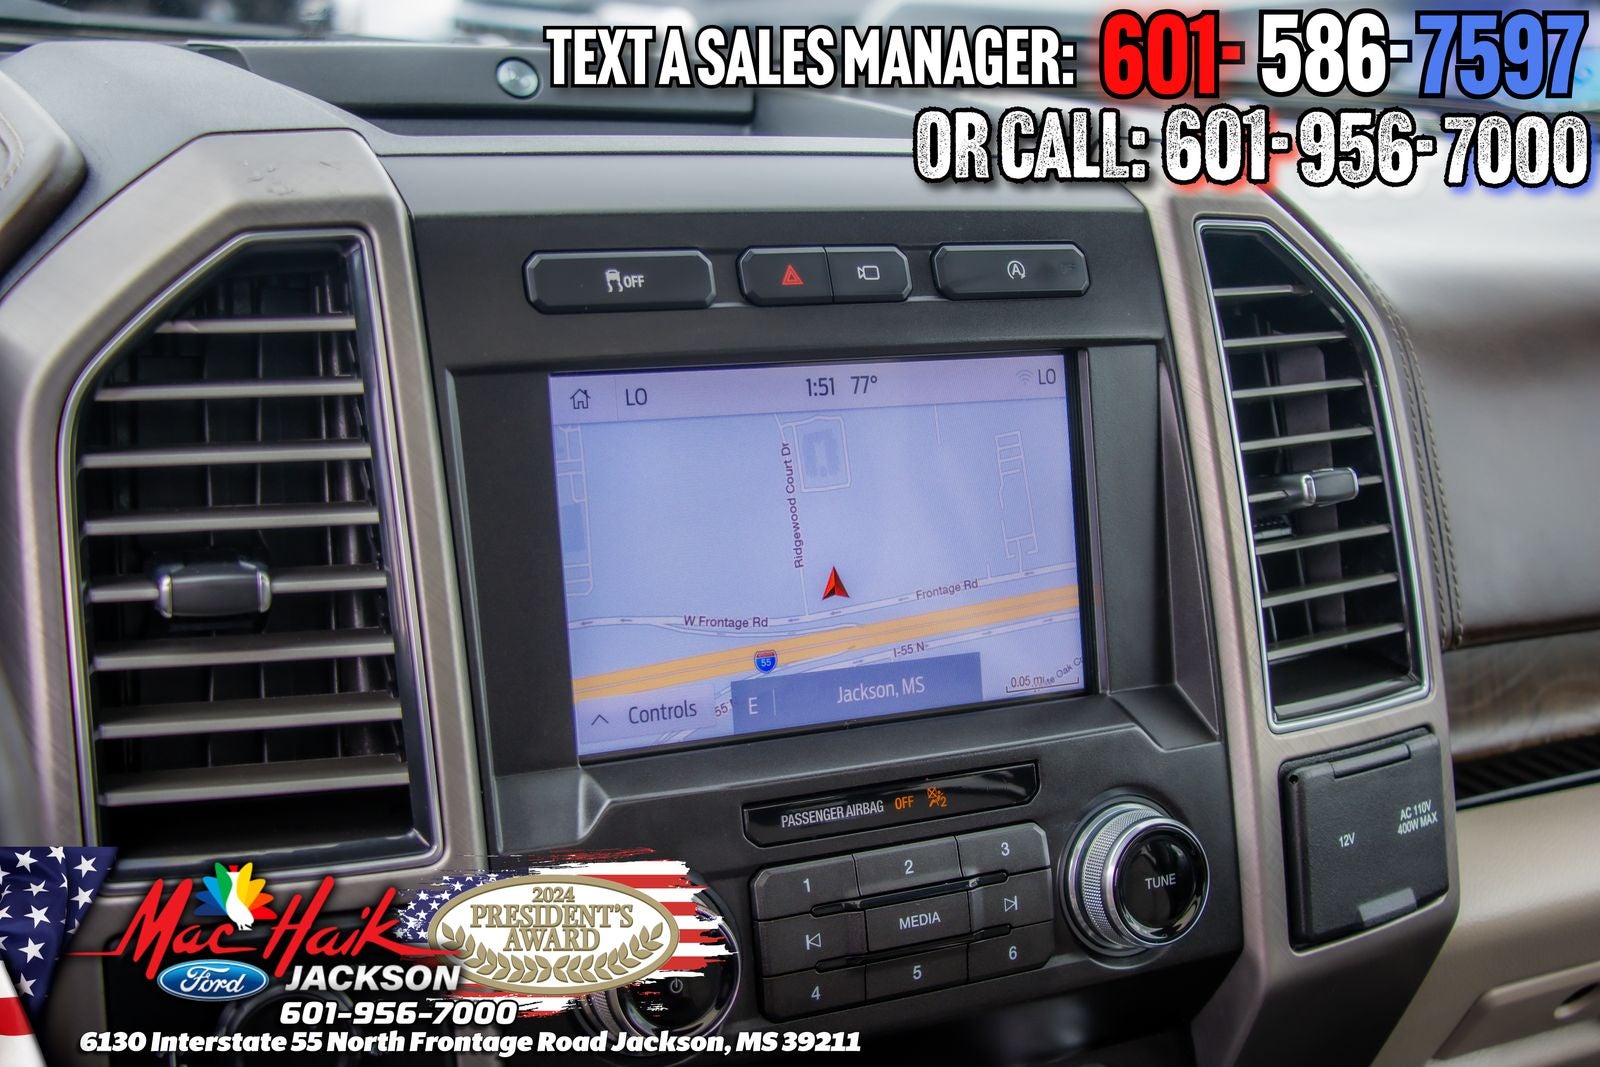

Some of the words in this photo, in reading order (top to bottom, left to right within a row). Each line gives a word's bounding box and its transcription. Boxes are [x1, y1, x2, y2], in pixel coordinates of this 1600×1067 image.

[623, 275, 645, 288] OFF
[1037, 369, 1057, 386] LO
[805, 377, 835, 397] 1:51
[850, 375, 878, 395] 77°
[625, 388, 648, 407] LO
[781, 442, 791, 456] Dr
[783, 459, 796, 494] Court
[787, 497, 804, 569] Ridgewood
[916, 582, 961, 601] Frontage
[964, 578, 979, 591] Rd
[683, 615, 696, 626] W
[698, 615, 749, 630] Frontage
[753, 617, 769, 628] Rd
[893, 644, 914, 658] I-55
[760, 658, 772, 667] 55
[1056, 664, 1073, 679] Oak
[1010, 675, 1031, 688] 0.05
[837, 682, 899, 704] Jackson,
[902, 676, 926, 695] MS
[628, 700, 698, 724] Controls
[748, 696, 759, 715] E
[781, 806, 845, 828] PASSENGER
[846, 800, 884, 818] AIRBAG
[894, 796, 914, 810] OFF
[1400, 807, 1412, 821] AC
[1413, 800, 1432, 816] 110V
[1398, 817, 1419, 835] 400W
[1420, 811, 1438, 828] MAX
[1339, 832, 1355, 847] 12V
[1000, 841, 1010, 856] 3
[904, 859, 914, 874] 2
[803, 879, 811, 893] 1
[1145, 873, 1177, 890] TUNE
[899, 911, 941, 930] MEDIA
[1008, 945, 1017, 961] 6
[913, 965, 922, 980] 5
[811, 985, 821, 1000] 4
